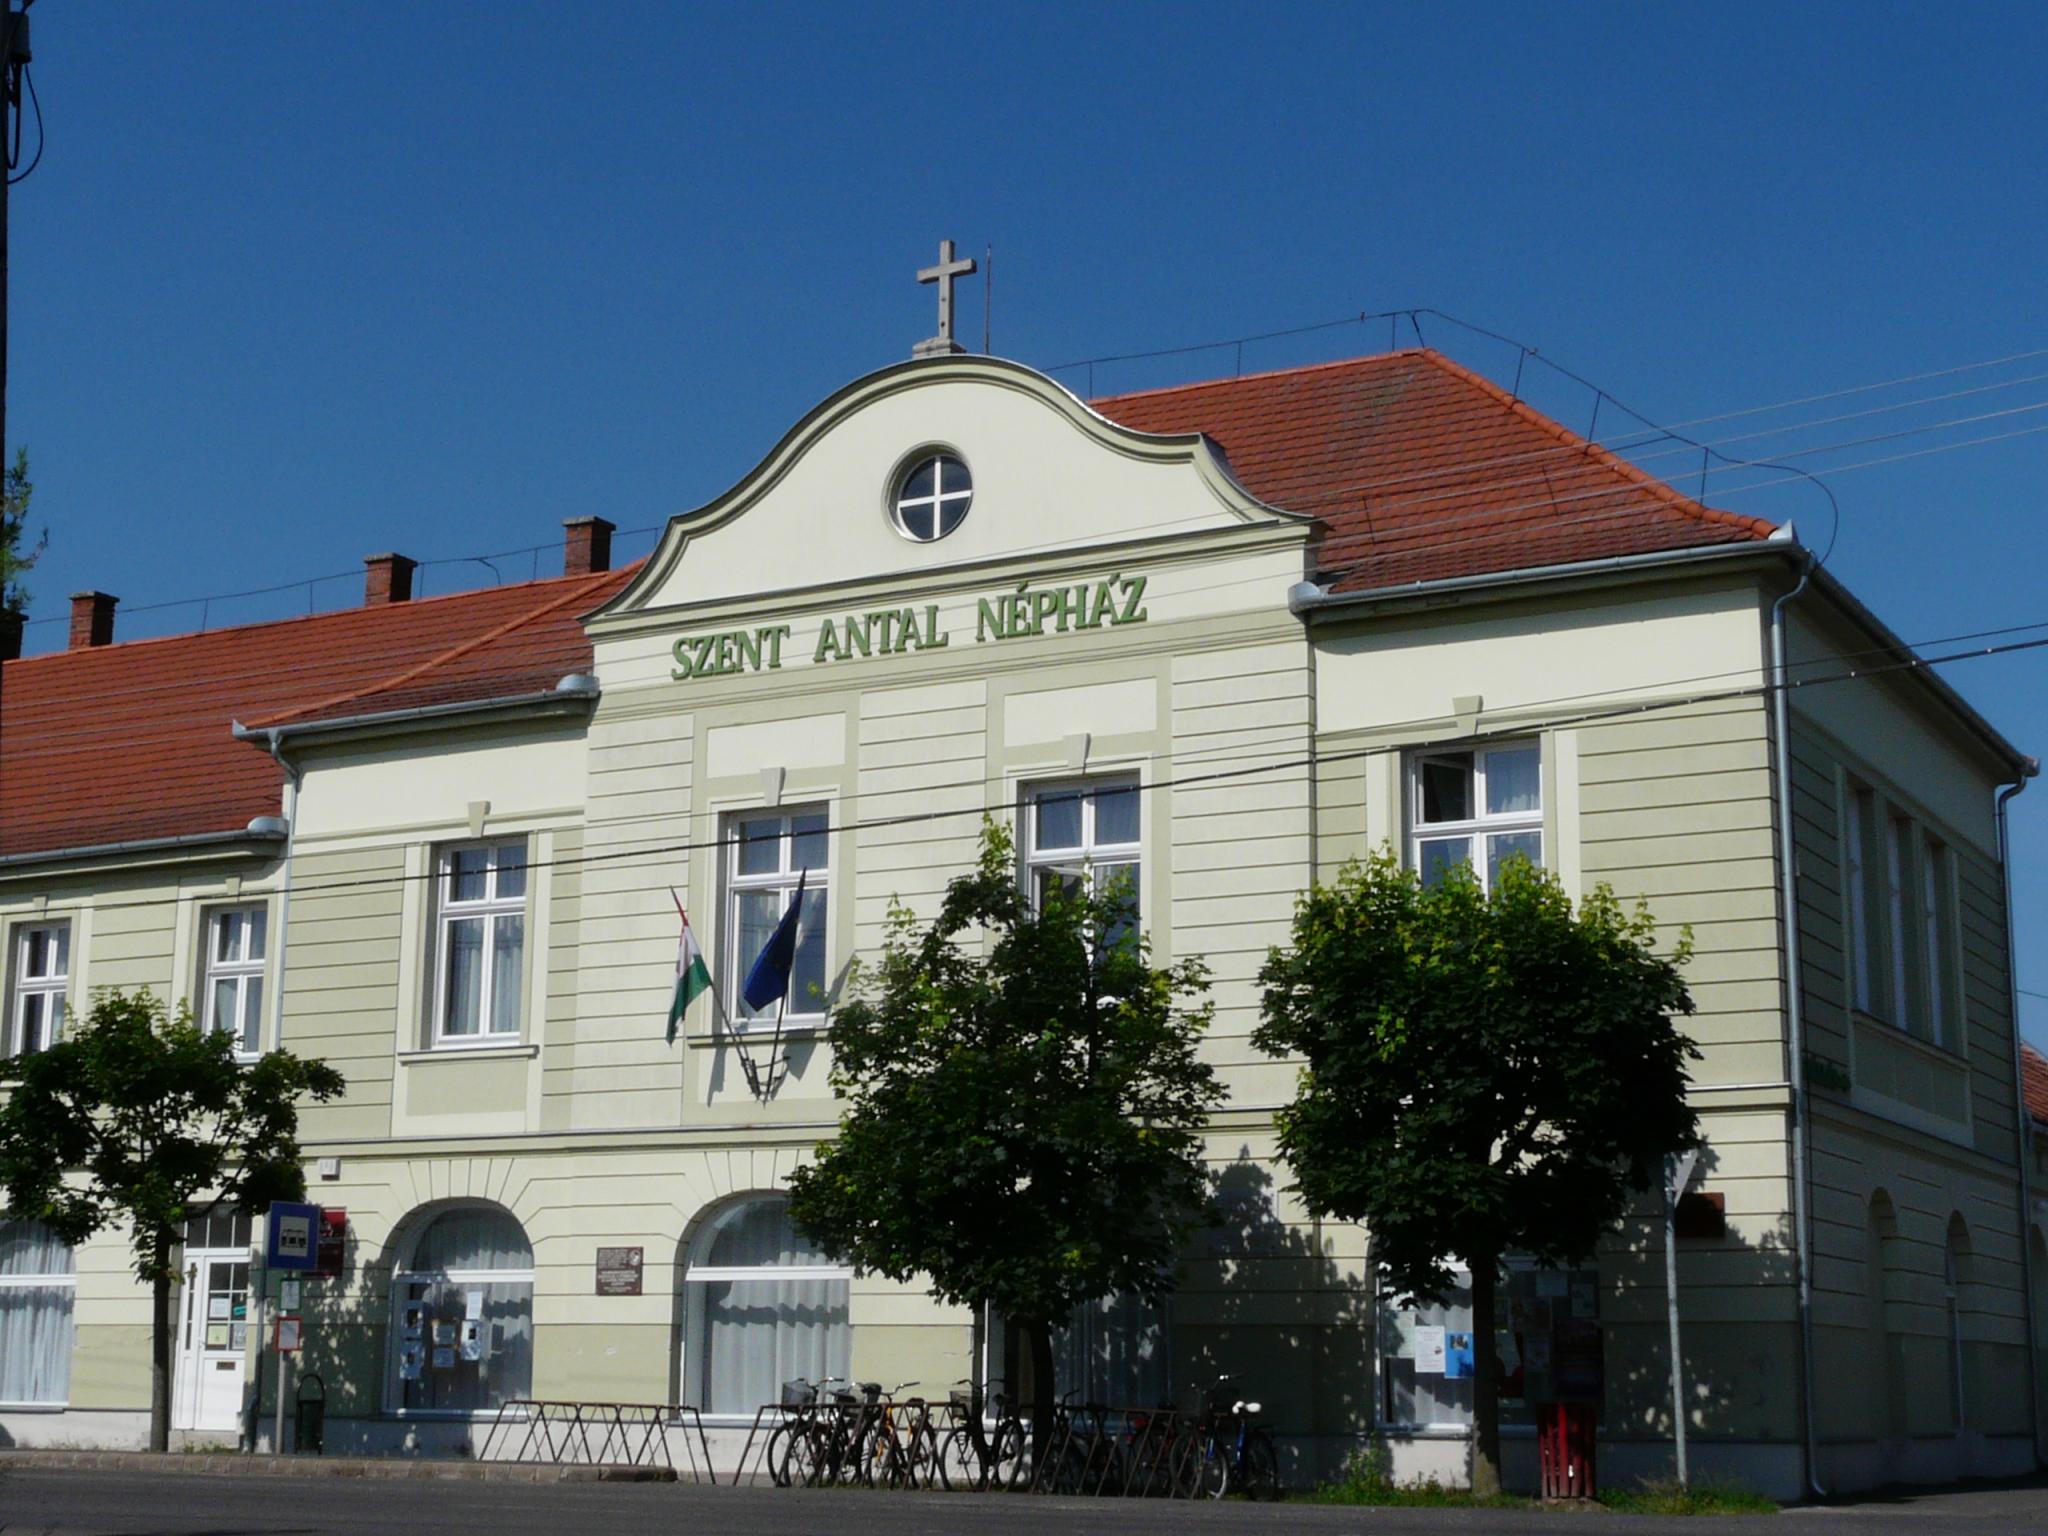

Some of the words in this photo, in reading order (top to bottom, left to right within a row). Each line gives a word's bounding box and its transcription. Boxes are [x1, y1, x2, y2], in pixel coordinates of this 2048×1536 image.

[671, 625, 790, 680] SZENT
[814, 605, 948, 663] ANTAL
[976, 573, 1148, 642] NÉPHÁZ
